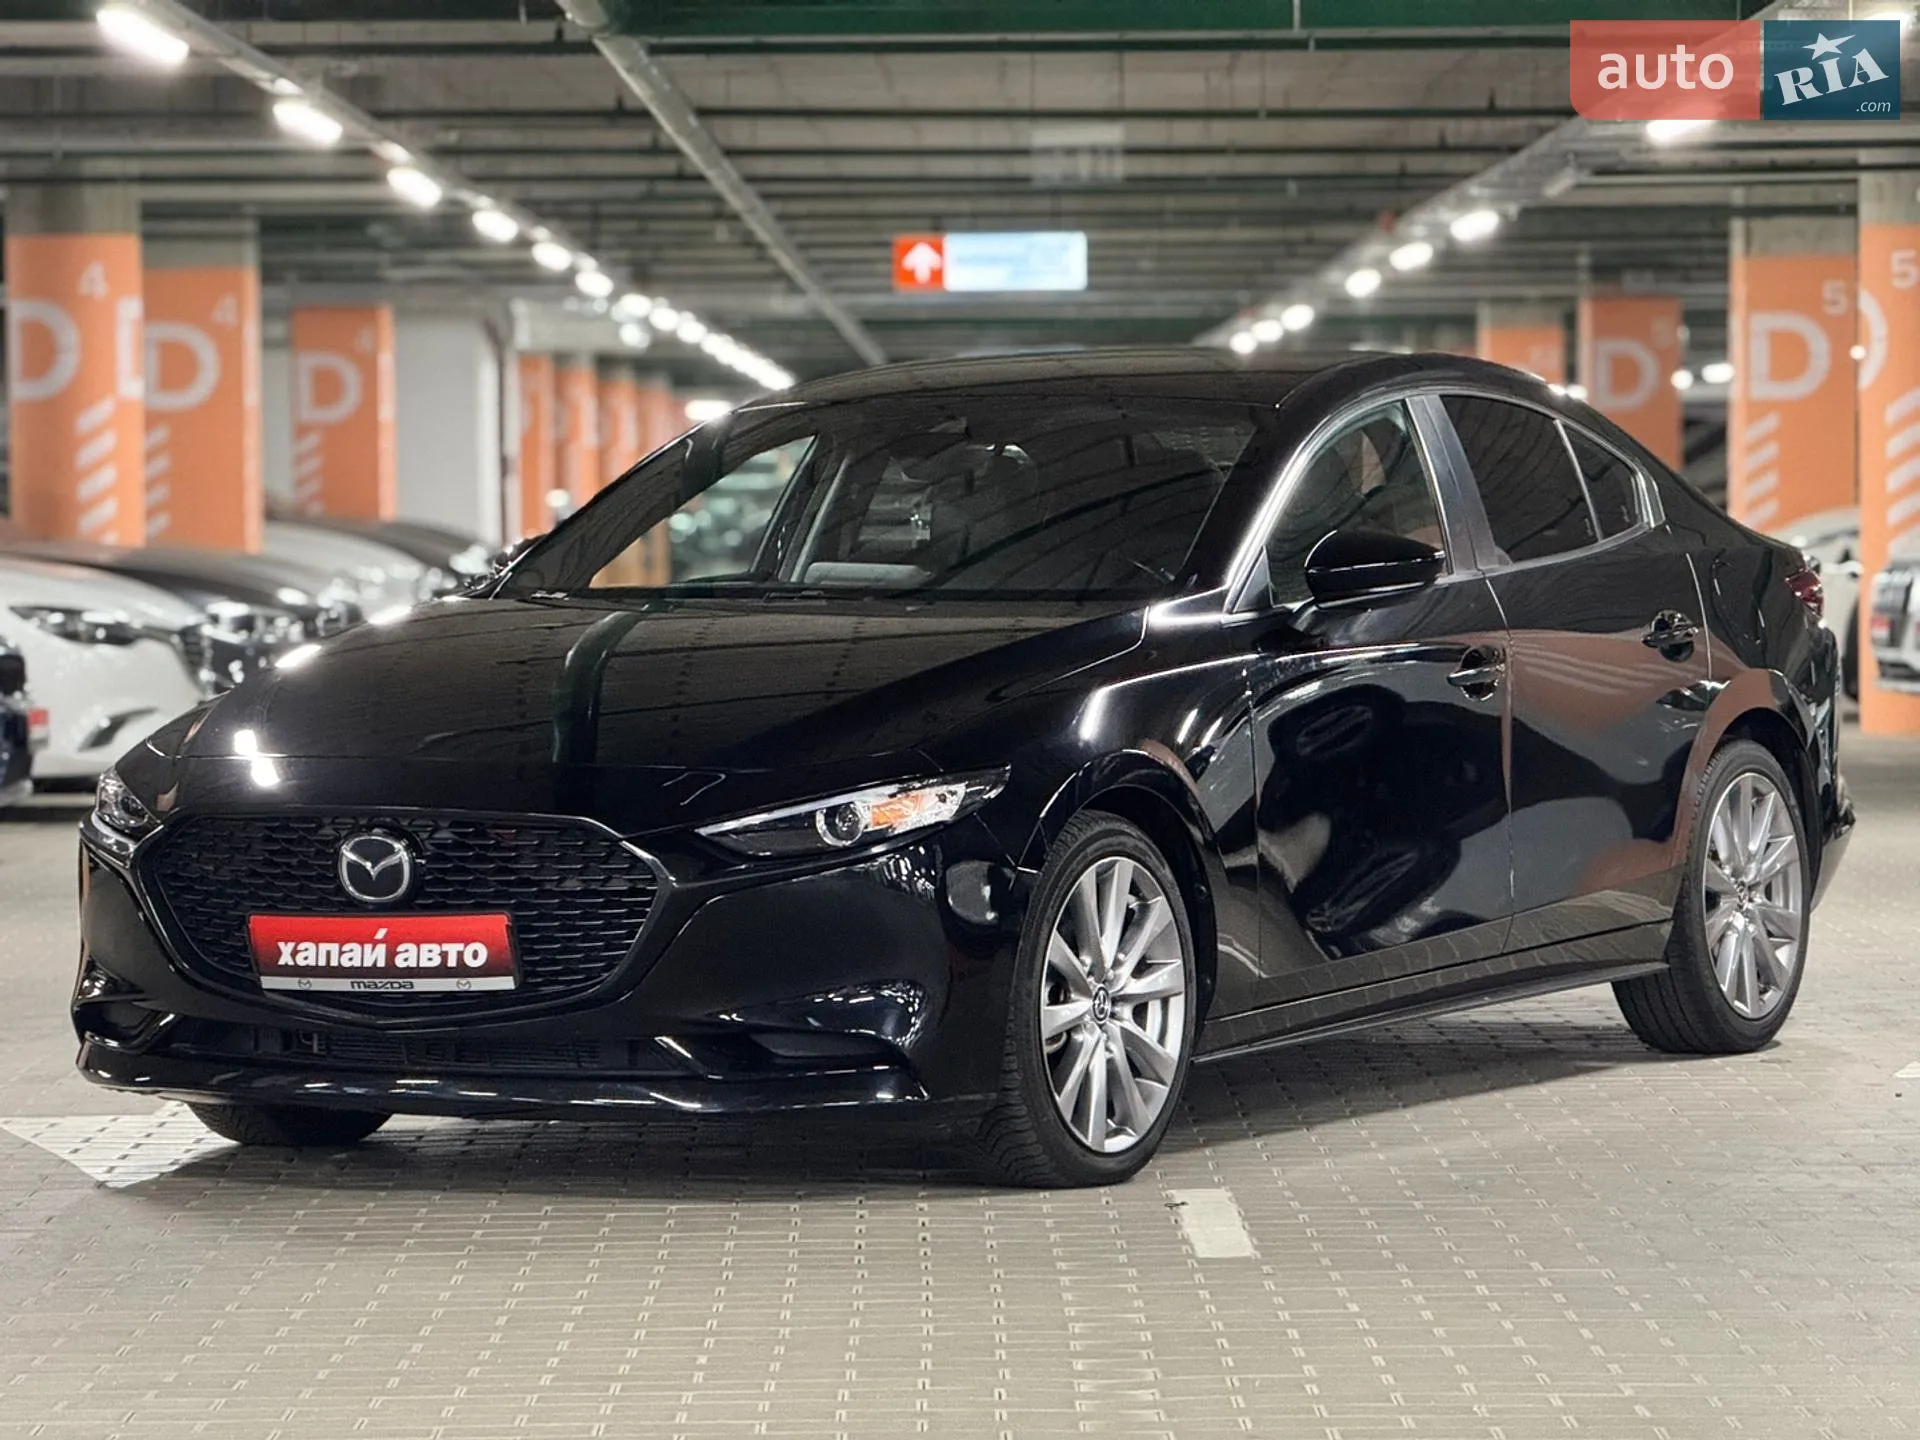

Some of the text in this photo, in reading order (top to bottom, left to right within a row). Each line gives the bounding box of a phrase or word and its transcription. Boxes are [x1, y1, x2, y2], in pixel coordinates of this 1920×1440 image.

[143, 320, 221, 413] D
[297, 347, 363, 425] D
[1595, 336, 1660, 412] D
[1749, 312, 1832, 402] D
[394, 941, 488, 968] авто
